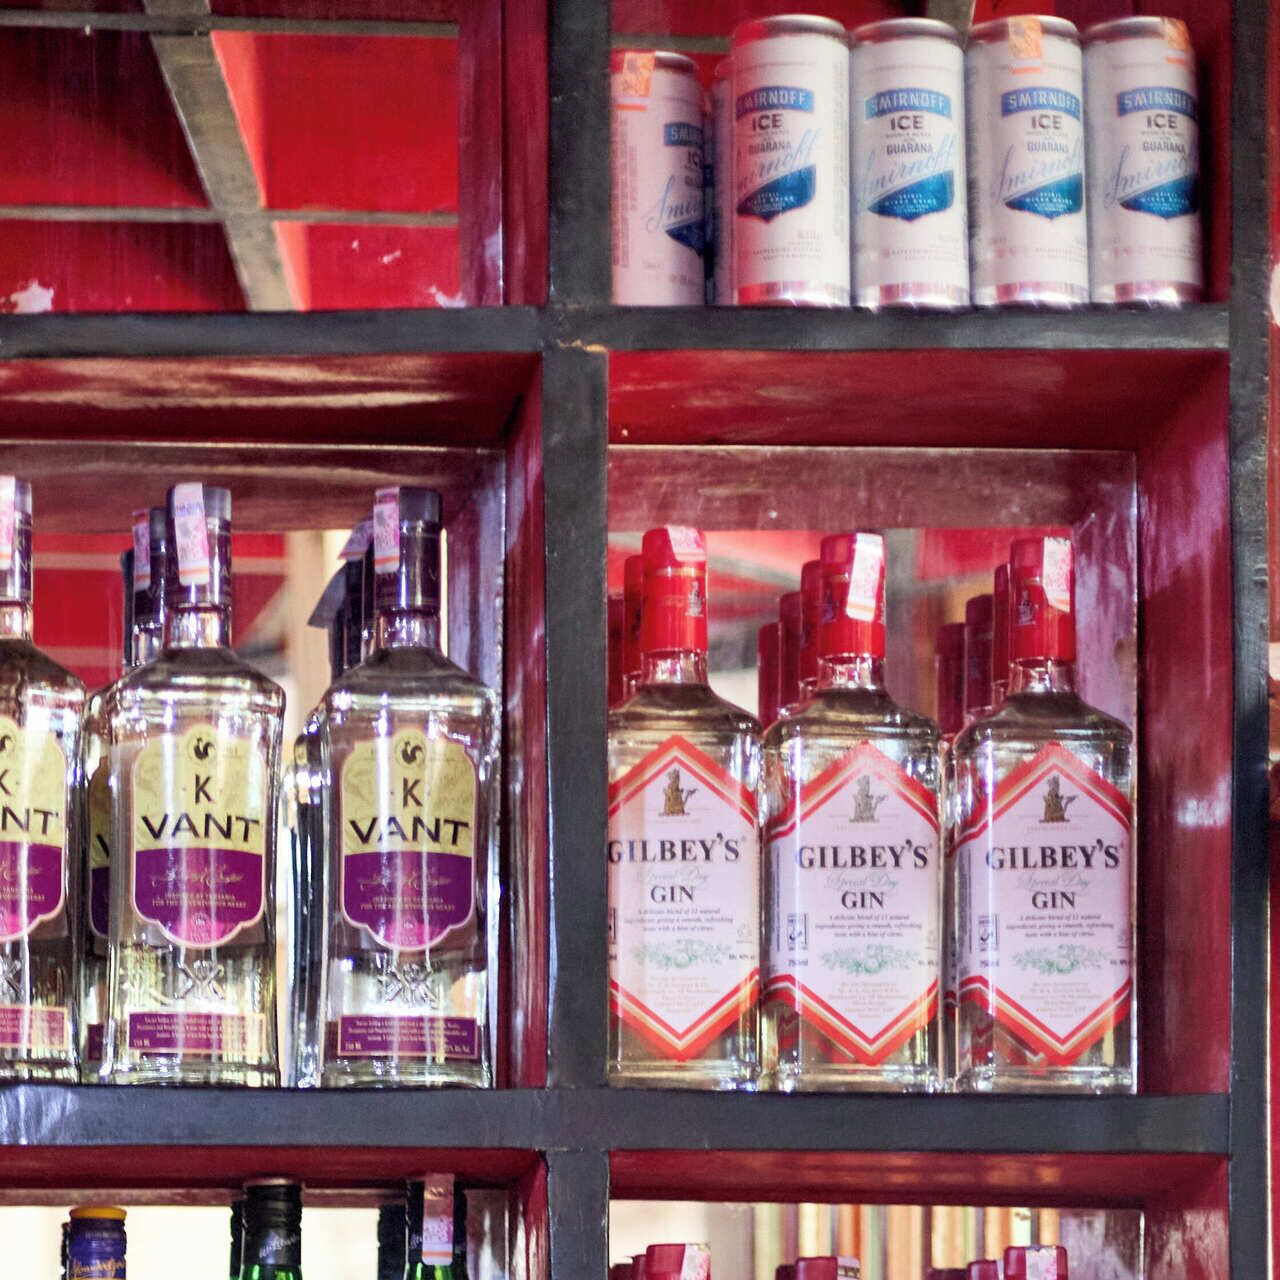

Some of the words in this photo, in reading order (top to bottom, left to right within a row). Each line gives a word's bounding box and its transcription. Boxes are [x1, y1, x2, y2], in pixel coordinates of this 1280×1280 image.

[871, 90, 946, 111] SMIRNOFF
[1009, 88, 1080, 110] SMIRNOFF
[752, 112, 785, 131] ICE
[890, 114, 925, 131] ICE
[1030, 114, 1063, 131] ICE
[1146, 114, 1178, 131] ICE
[193, 773, 213, 804] K
[402, 776, 423, 808] K
[141, 812, 261, 843] VANT
[349, 816, 470, 846] VANT
[608, 832, 741, 863] GILBEY'S
[796, 838, 929, 869] GILBEY'S
[985, 838, 1121, 870] GILBEY'S
[650, 885, 696, 903] GIN
[841, 890, 885, 909] GIN
[1031, 890, 1077, 910] GIN
